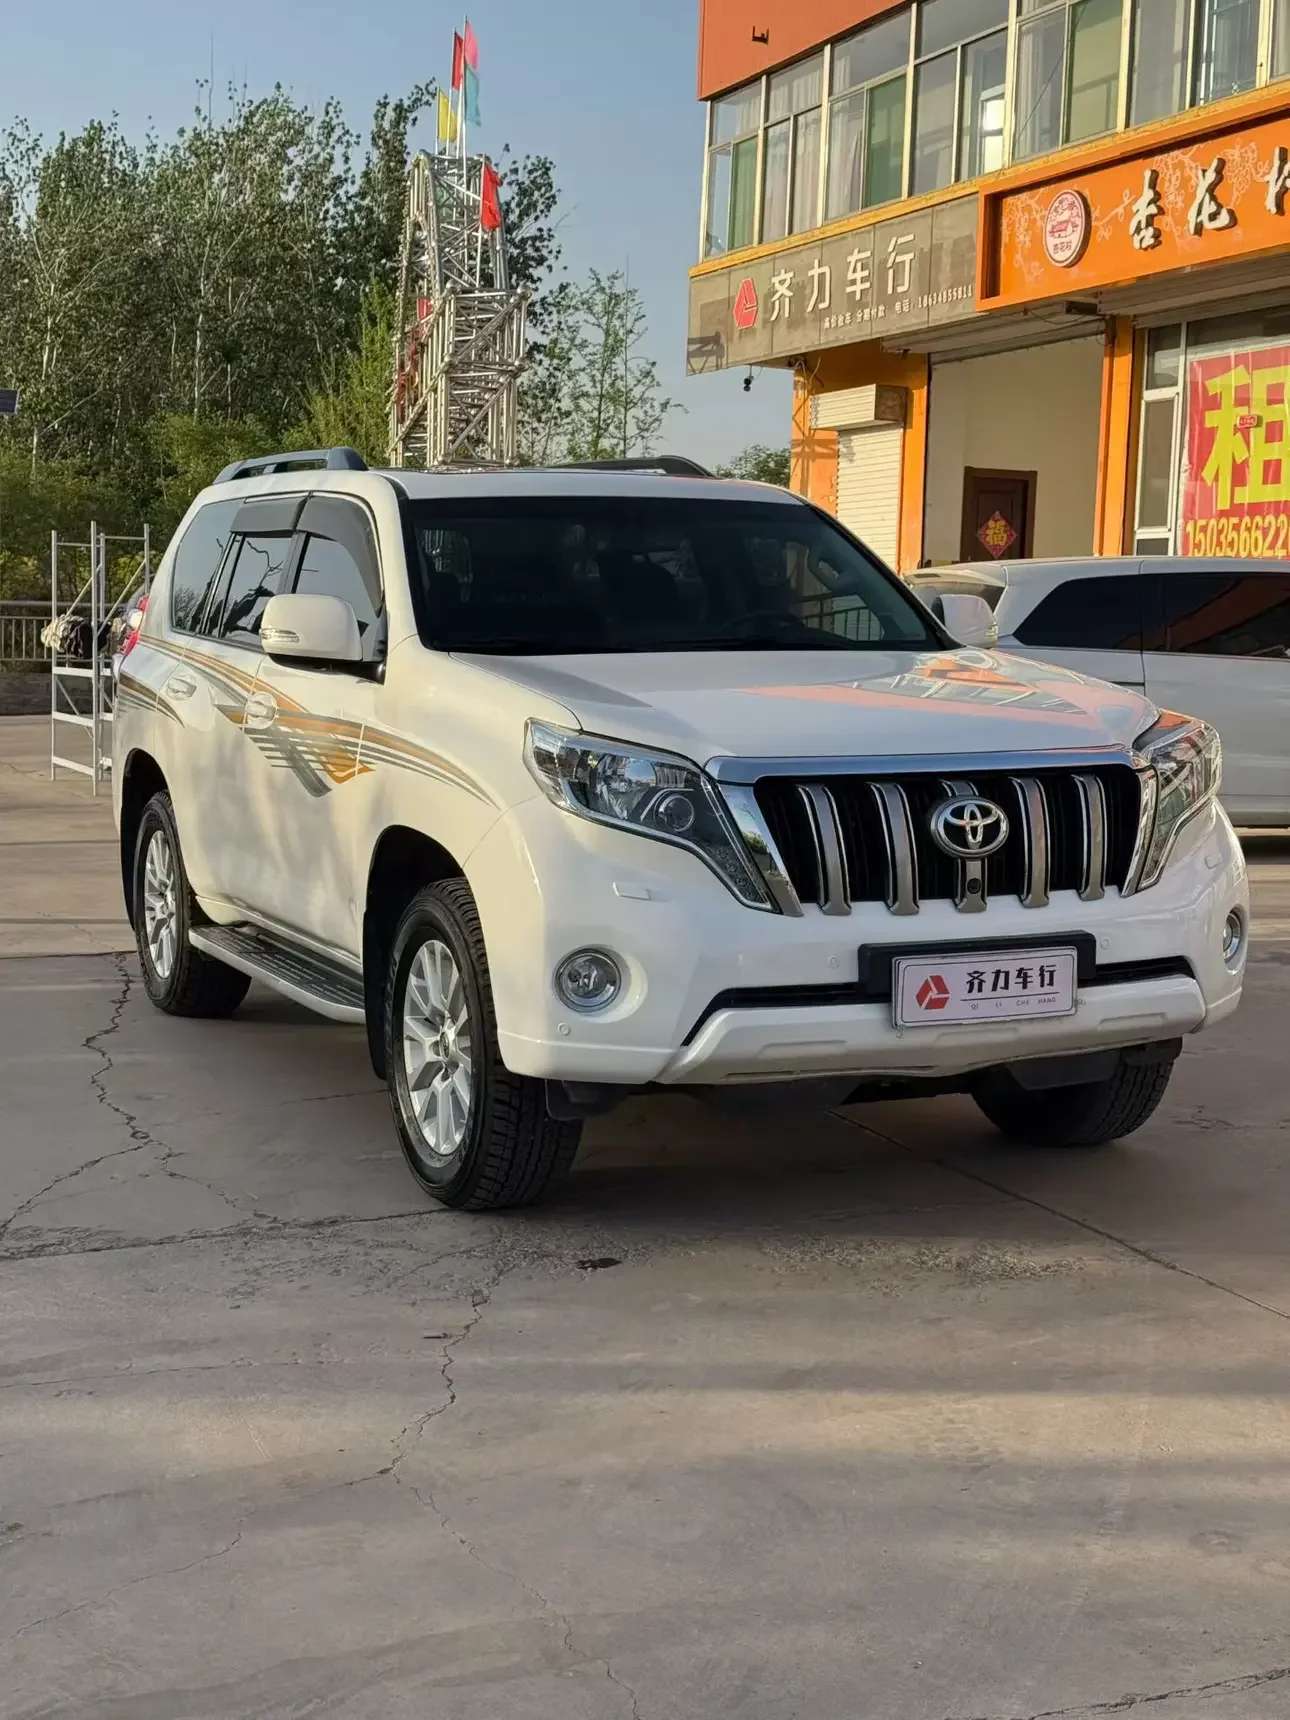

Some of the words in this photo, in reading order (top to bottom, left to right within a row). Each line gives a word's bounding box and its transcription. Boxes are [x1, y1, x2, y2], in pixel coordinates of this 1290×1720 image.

[770, 233, 916, 322] 齐力车行
[1201, 364, 1290, 511] 租
[1185, 513, 1290, 558] 150356622
[966, 964, 1057, 994] 齐力车行
[1037, 996, 1057, 1005] HANG
